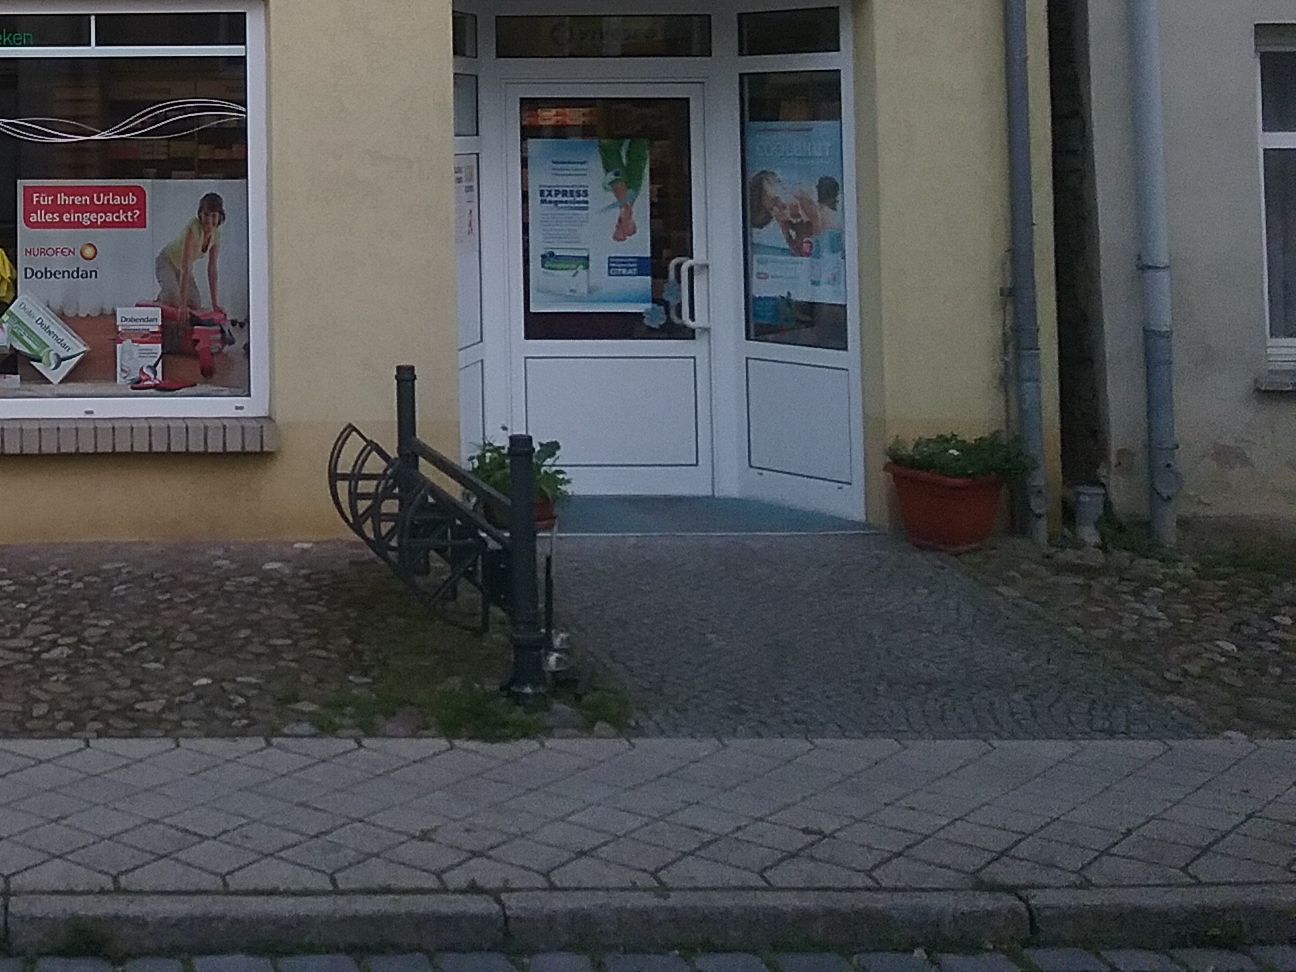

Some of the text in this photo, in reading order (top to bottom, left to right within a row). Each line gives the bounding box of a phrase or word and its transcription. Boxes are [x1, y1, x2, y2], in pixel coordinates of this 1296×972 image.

[32, 192, 137, 205] Für Ihren Urlaub
[539, 189, 589, 198] EXPRESS
[29, 210, 140, 226] alles eingepackt?
[24, 247, 76, 257] NUROFEN
[24, 267, 98, 280] Dobendan
[120, 315, 158, 323] Dobendan
[35, 317, 71, 352] Dobendan
